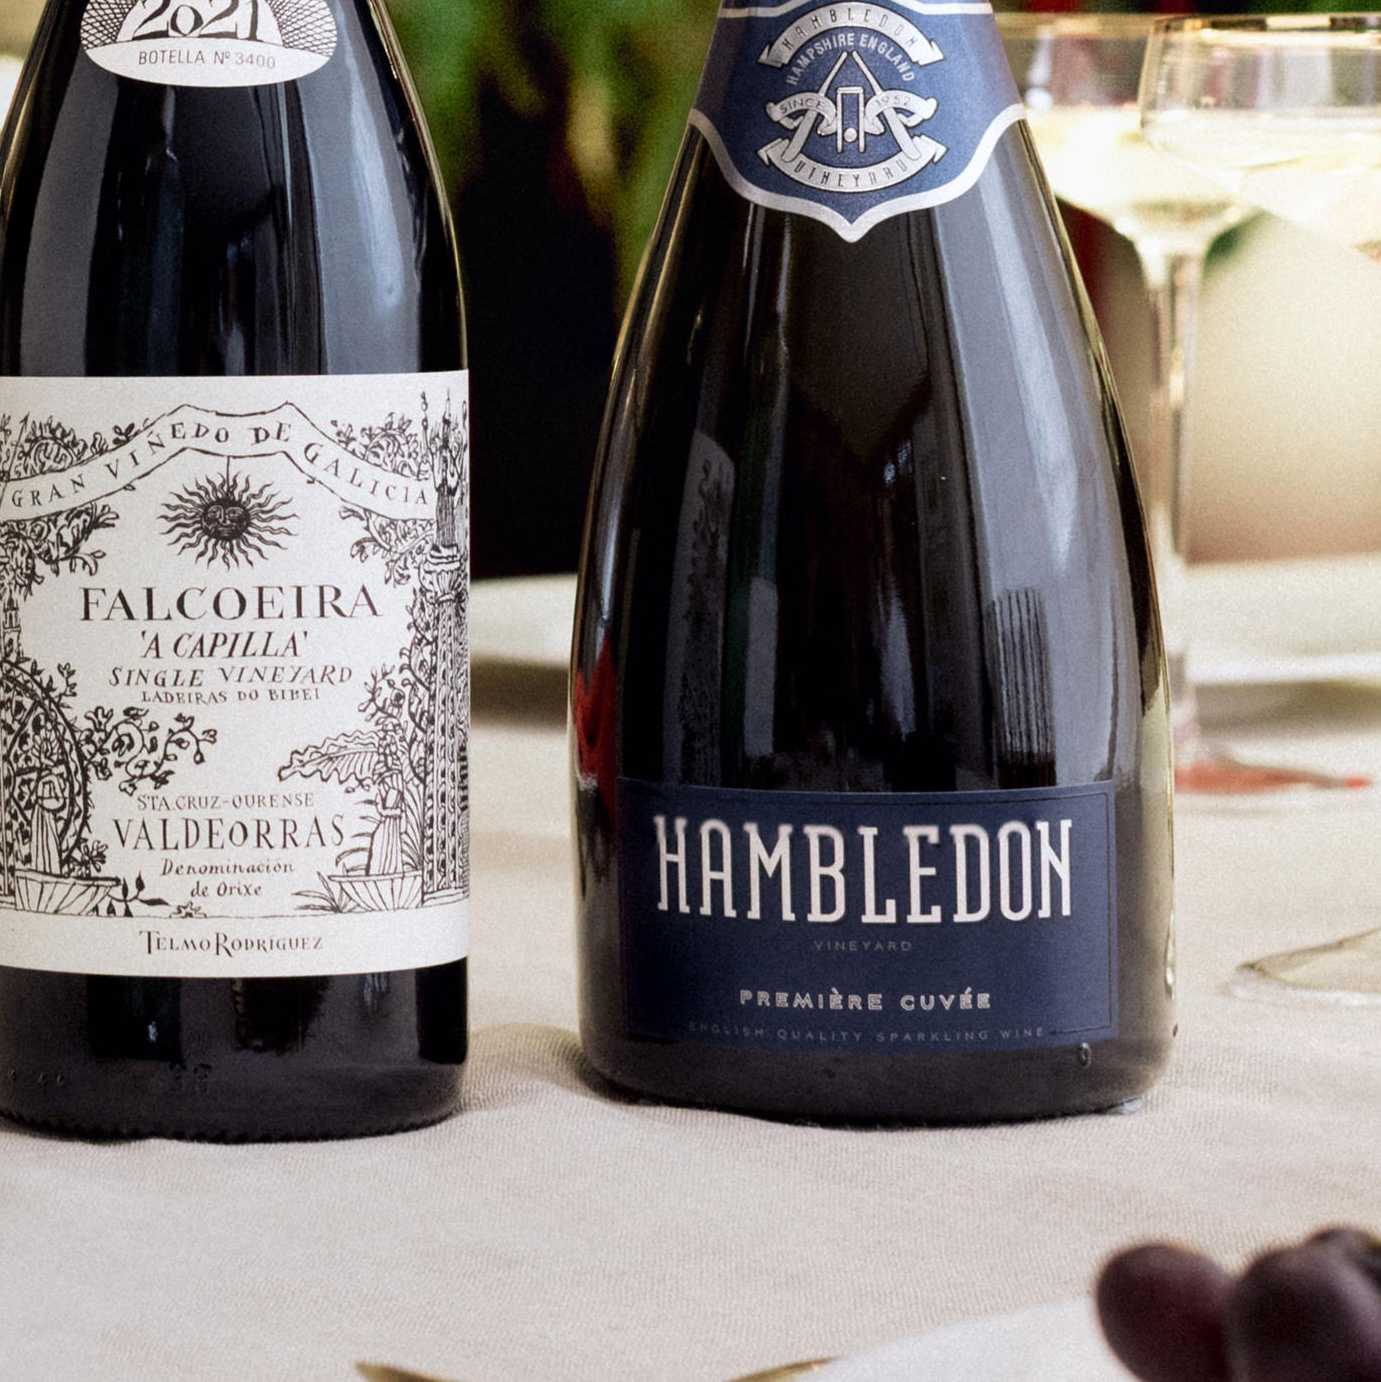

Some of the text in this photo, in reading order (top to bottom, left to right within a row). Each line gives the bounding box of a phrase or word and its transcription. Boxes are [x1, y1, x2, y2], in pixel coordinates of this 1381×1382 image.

[781, 8, 918, 50] HAMBLEDON
[138, 49, 205, 65] BOTELLA
[235, 52, 276, 69] 3400
[786, 33, 916, 85] HAMPSHIRE ENGLAND
[780, 97, 827, 114] SINCE
[875, 94, 912, 108] 1952
[12, 422, 428, 507] GRAN VIÑEDO DE GALICIA
[79, 584, 384, 622] FALCOEIRA
[109, 665, 353, 687] SINGLE VINEYARD
[142, 688, 320, 705] LADEIRAS DO BIBEI
[111, 814, 345, 851] VALDEORRAS
[654, 815, 1073, 924] HAMBLEDON
[190, 880, 262, 897] de Orixe
[814, 940, 912, 953] VINEYARD
[739, 986, 991, 1012] PREMIÈRE CUVÉE
[689, 1022, 1044, 1043] ENGLISH QUALITY SPARKLING WINE
